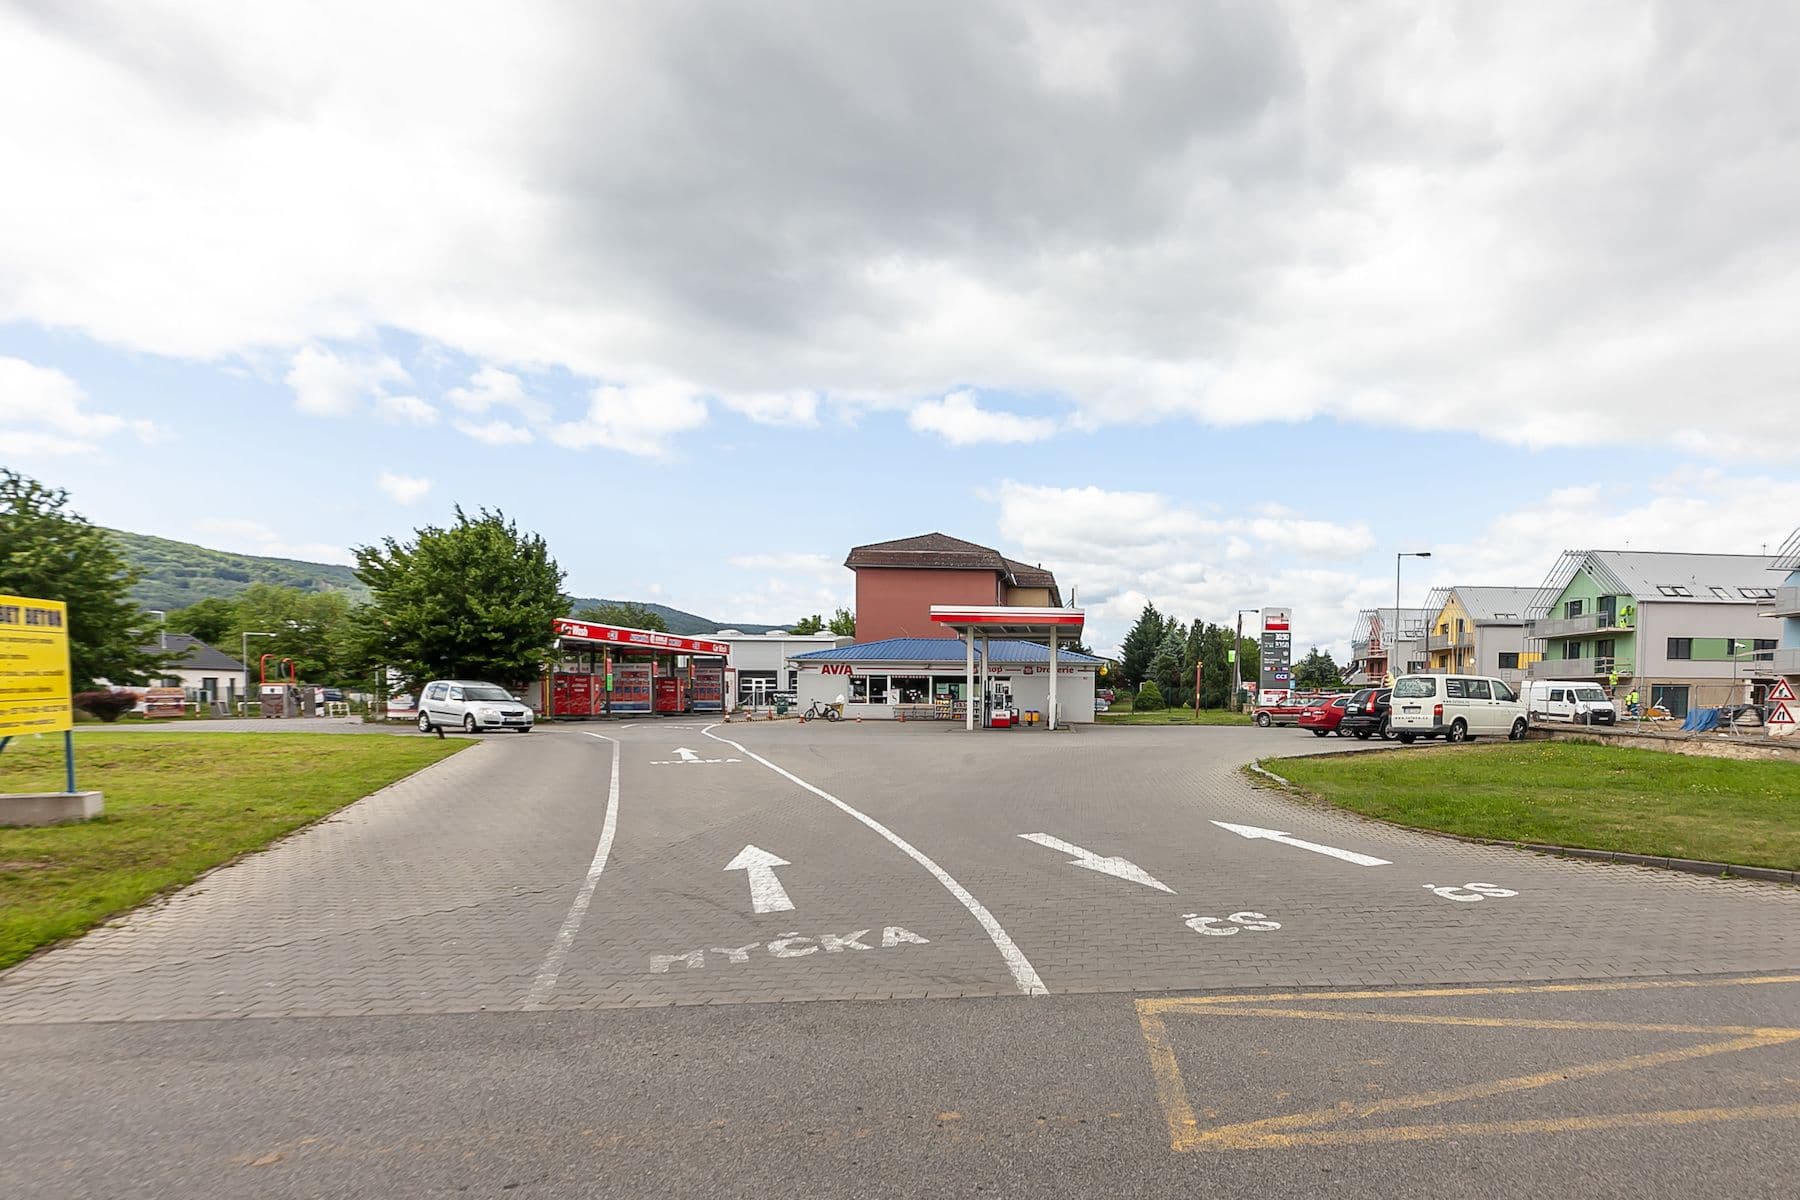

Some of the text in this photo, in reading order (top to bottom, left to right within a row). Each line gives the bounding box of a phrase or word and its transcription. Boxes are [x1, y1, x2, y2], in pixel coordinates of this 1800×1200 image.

[821, 664, 853, 675] AVIA
[1036, 665, 1074, 674] Droerie
[649, 926, 931, 973] MYČKA
